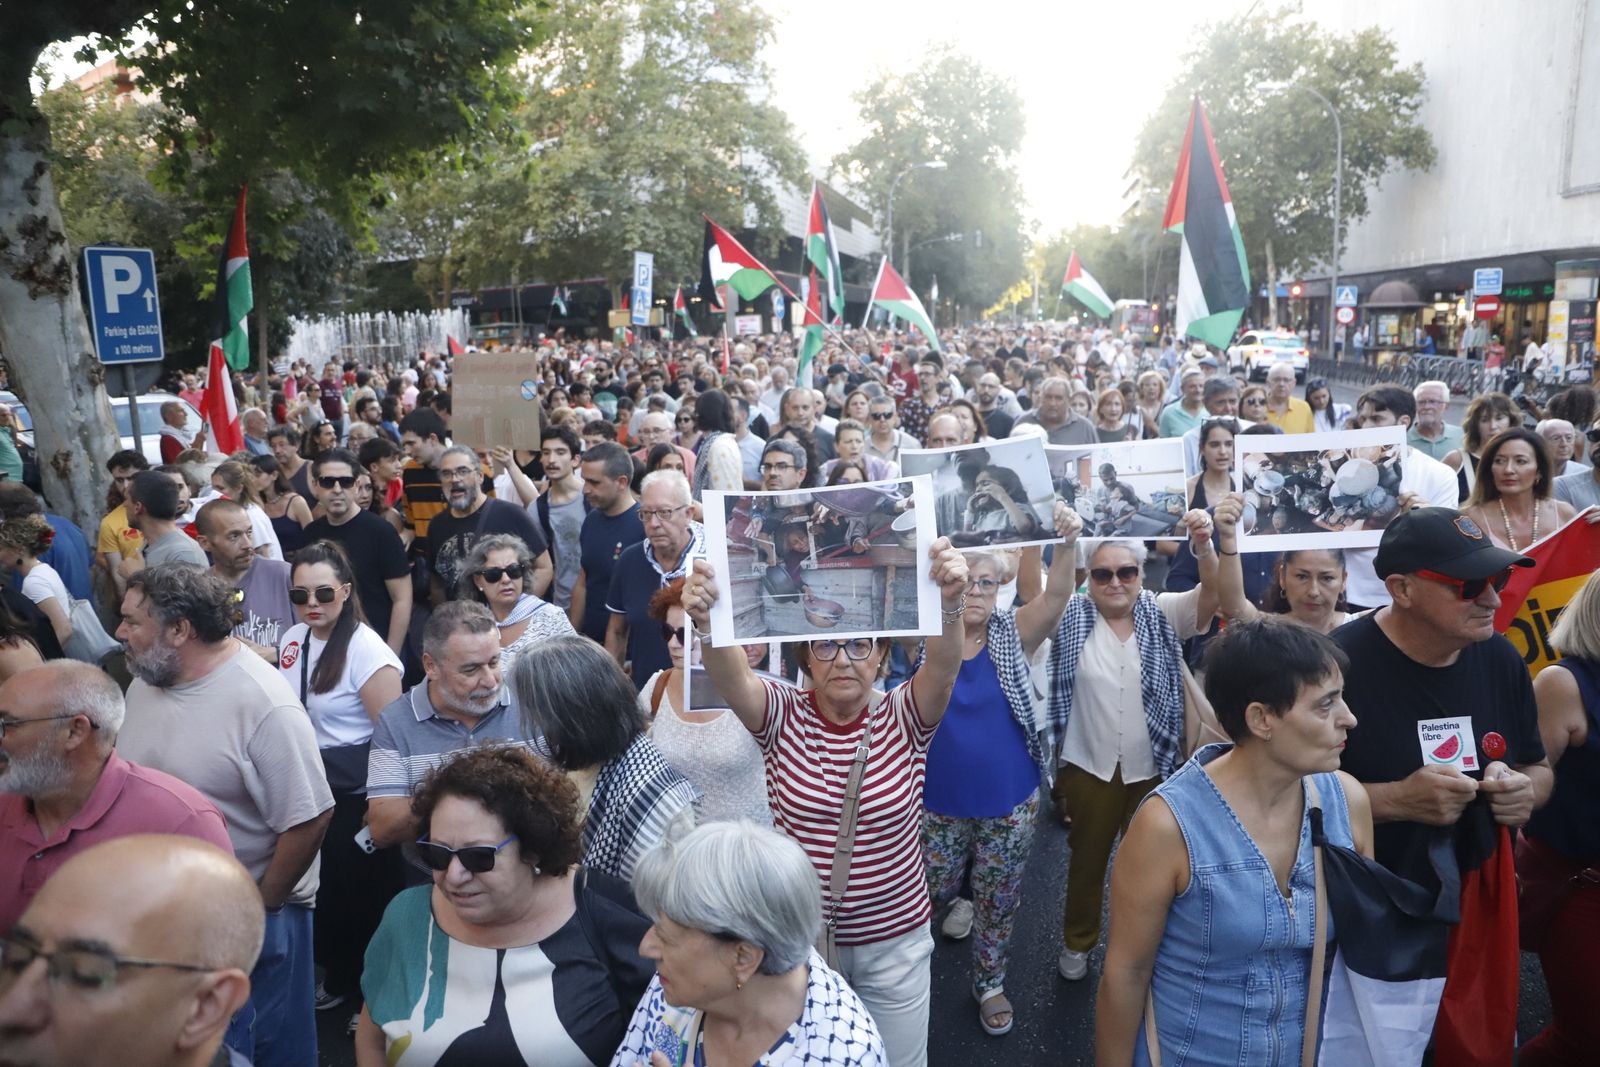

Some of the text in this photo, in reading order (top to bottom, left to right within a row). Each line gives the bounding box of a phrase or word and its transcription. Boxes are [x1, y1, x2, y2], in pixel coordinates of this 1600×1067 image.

[101, 255, 142, 313] P
[104, 326, 128, 338] Parking
[128, 326, 137, 336] de
[120, 344, 131, 354] 100
[132, 343, 153, 354] metros
[1421, 722, 1460, 732] Palestina
[1422, 733, 1444, 742] libre.
